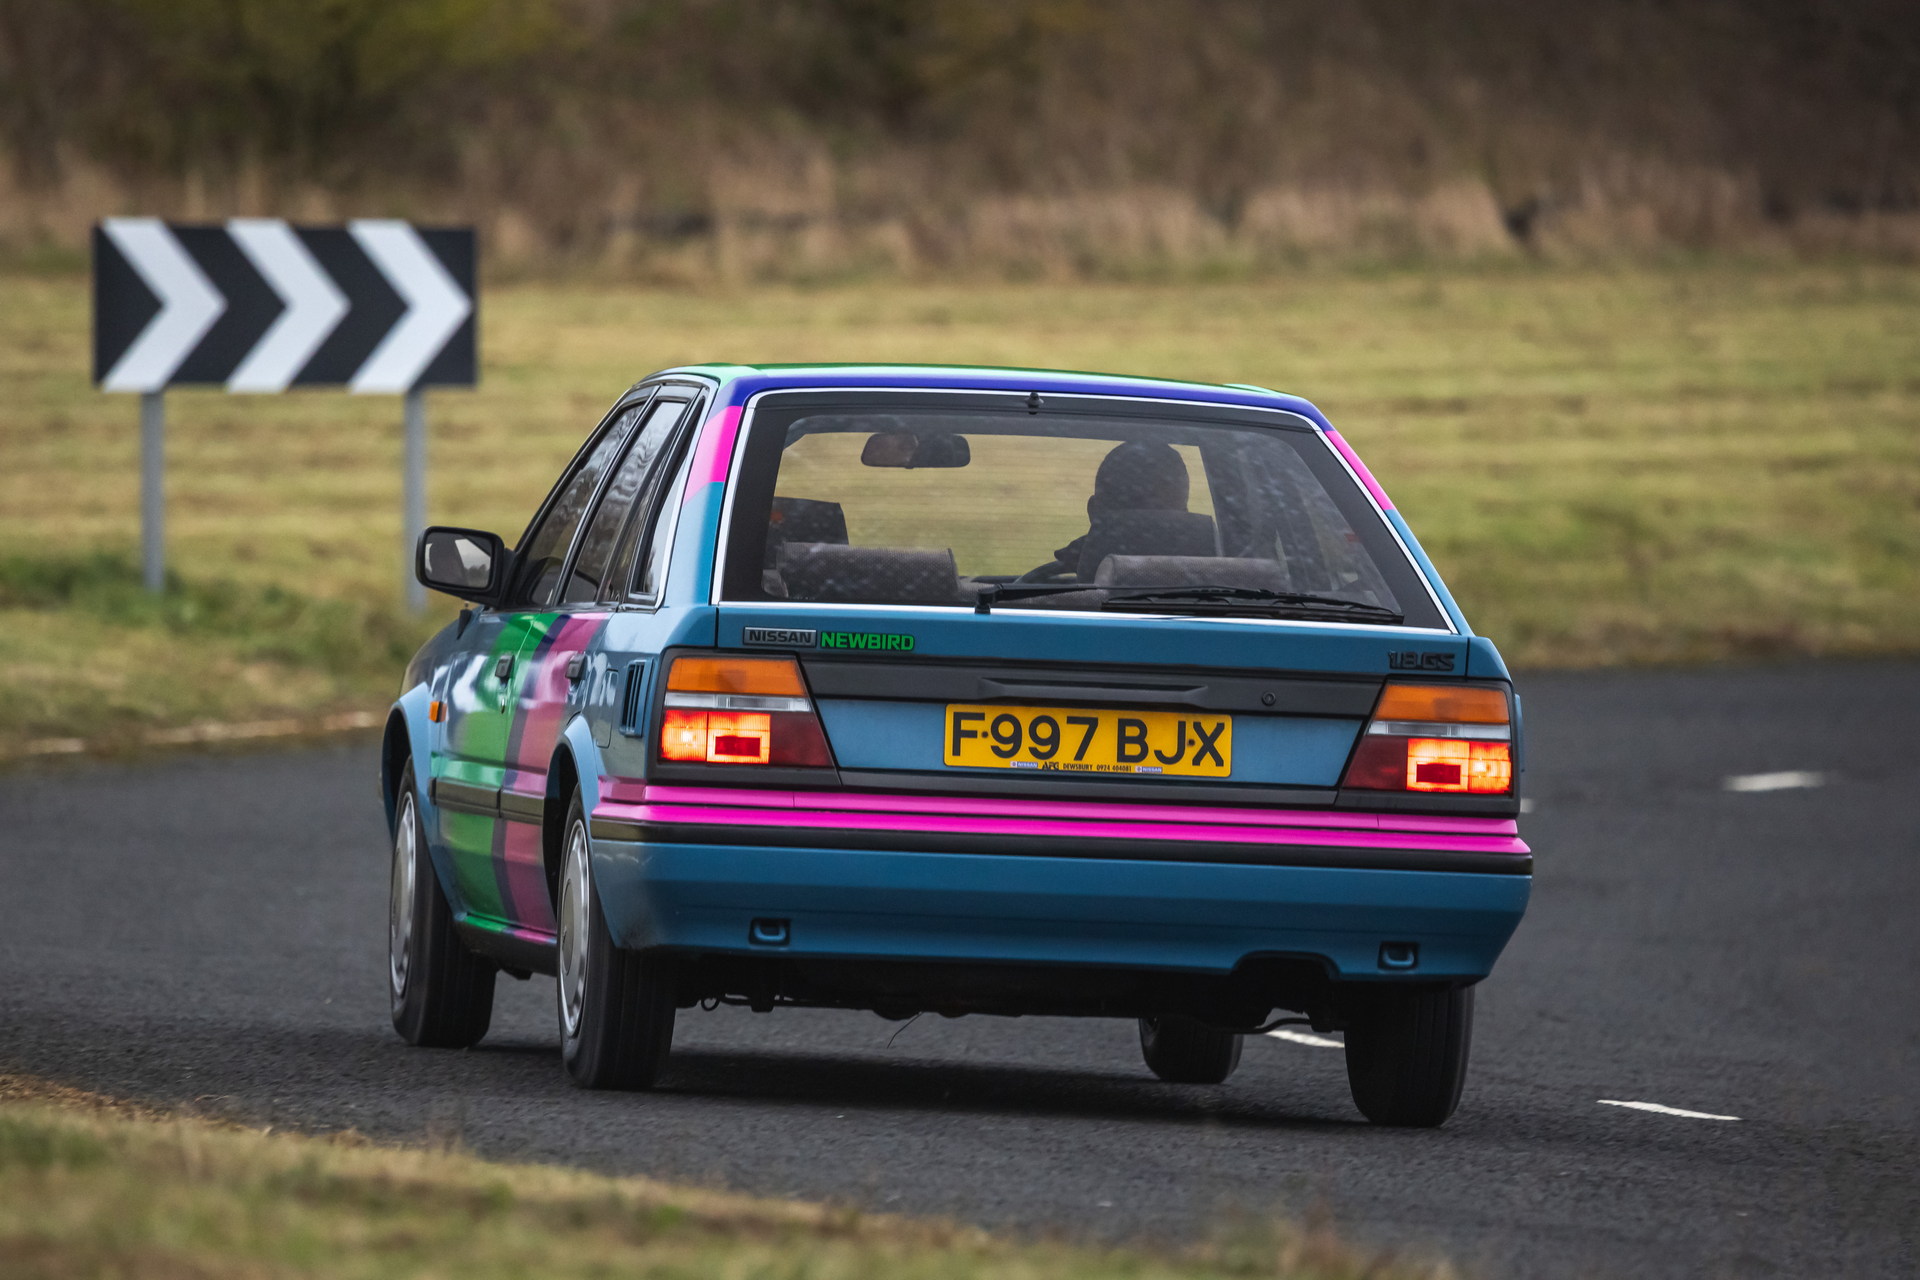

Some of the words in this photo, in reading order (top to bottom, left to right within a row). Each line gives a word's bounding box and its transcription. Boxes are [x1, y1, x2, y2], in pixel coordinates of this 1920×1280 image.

[749, 629, 812, 644] NISSAN
[820, 631, 915, 650] NEWBIRD
[951, 711, 1099, 762] F997
[1116, 717, 1225, 767] BJX
